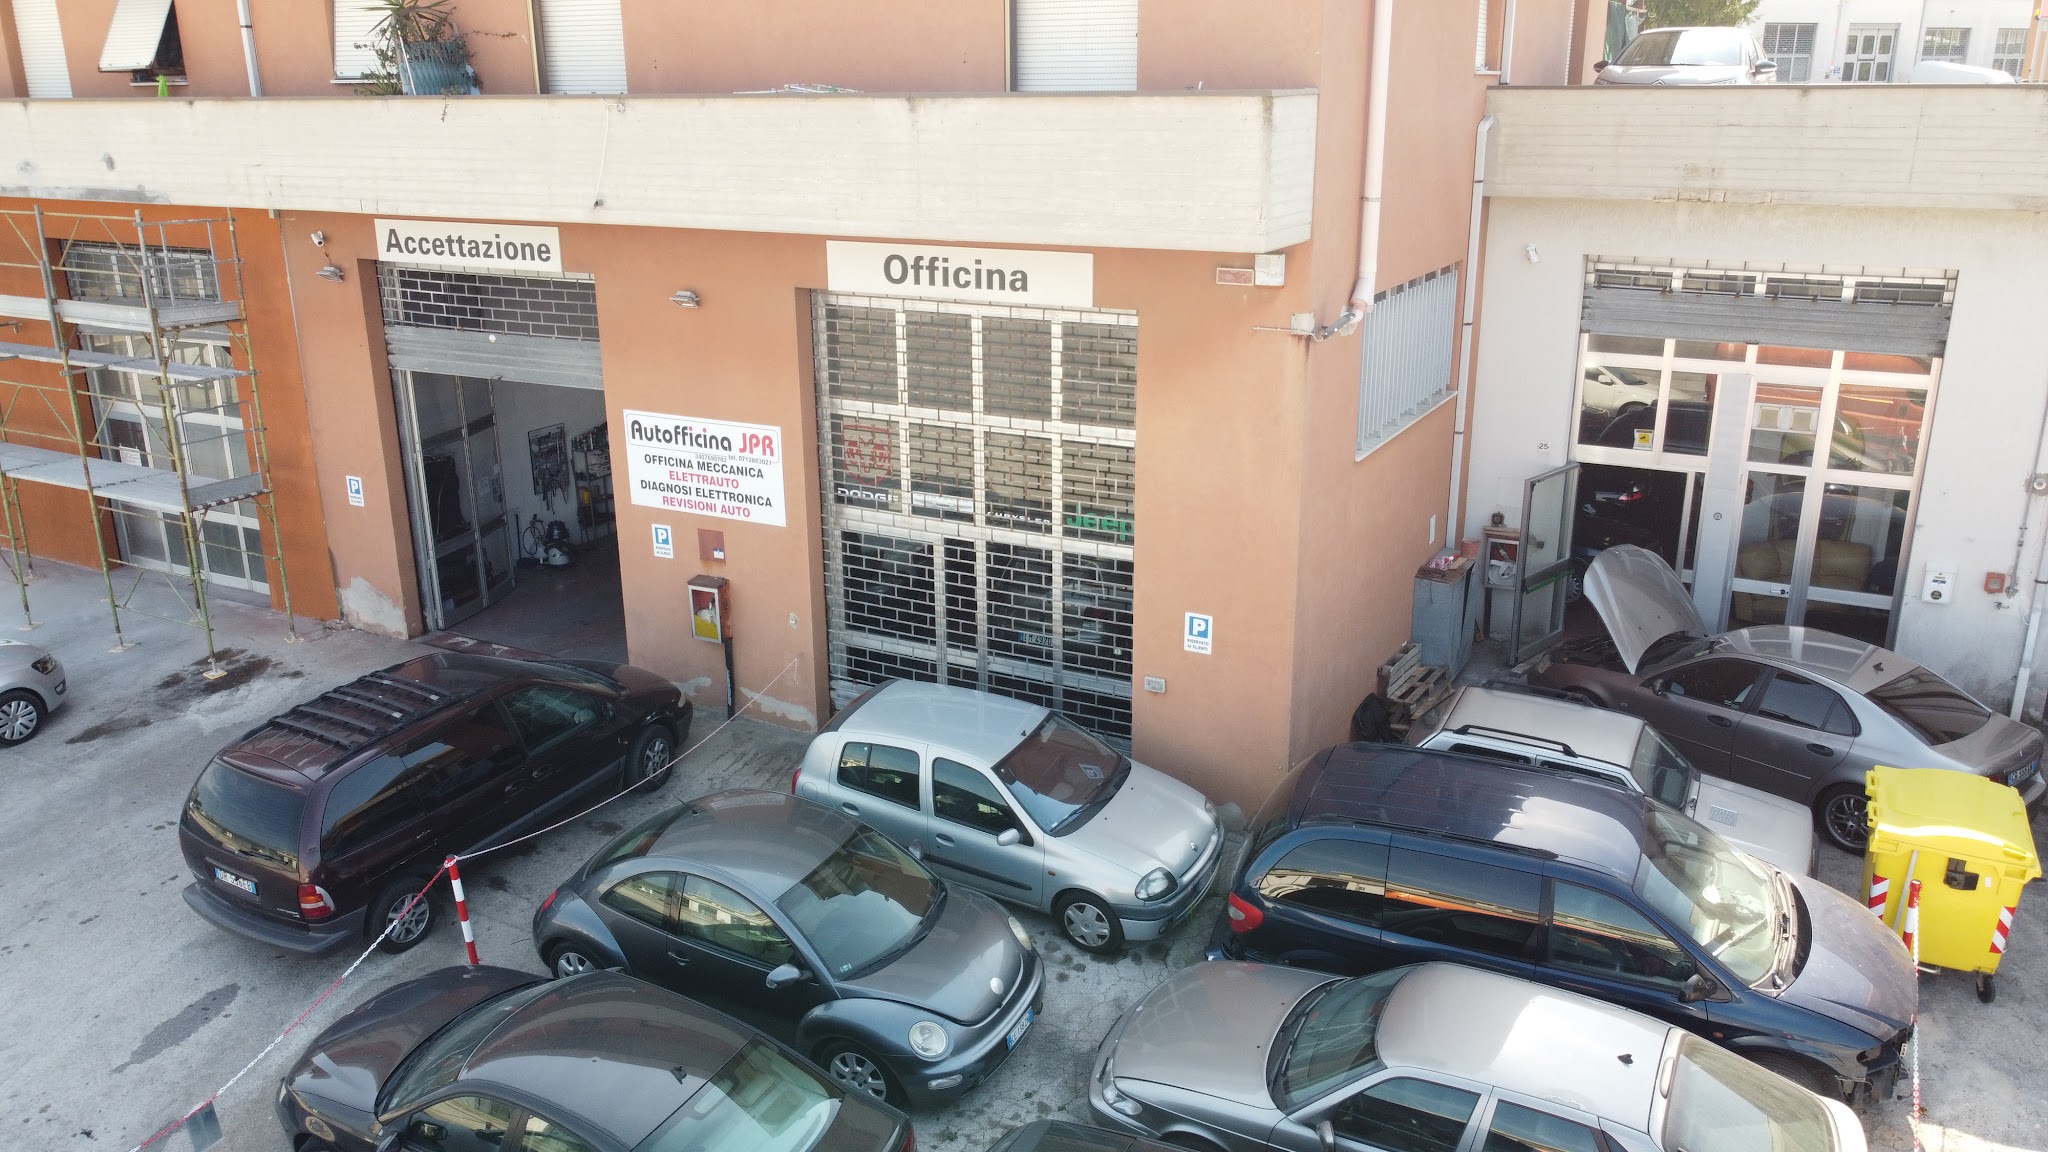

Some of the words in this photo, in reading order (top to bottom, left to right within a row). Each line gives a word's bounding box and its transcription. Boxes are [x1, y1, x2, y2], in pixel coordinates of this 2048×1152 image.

[386, 228, 551, 262] Accettazione
[883, 254, 1028, 292] Officina
[630, 419, 732, 451] Autofficina
[738, 432, 775, 457] JPR
[644, 453, 693, 470] OFFICINA
[697, 461, 764, 479] MECCANICA
[669, 470, 739, 489] ELETTRAUTO
[640, 479, 692, 496] DIAGNOSI
[695, 487, 772, 508] ELETTRONICA
[662, 495, 717, 513] REVISIONI
[720, 504, 750, 518] AUTO
[1066, 502, 1134, 542] Jeep
